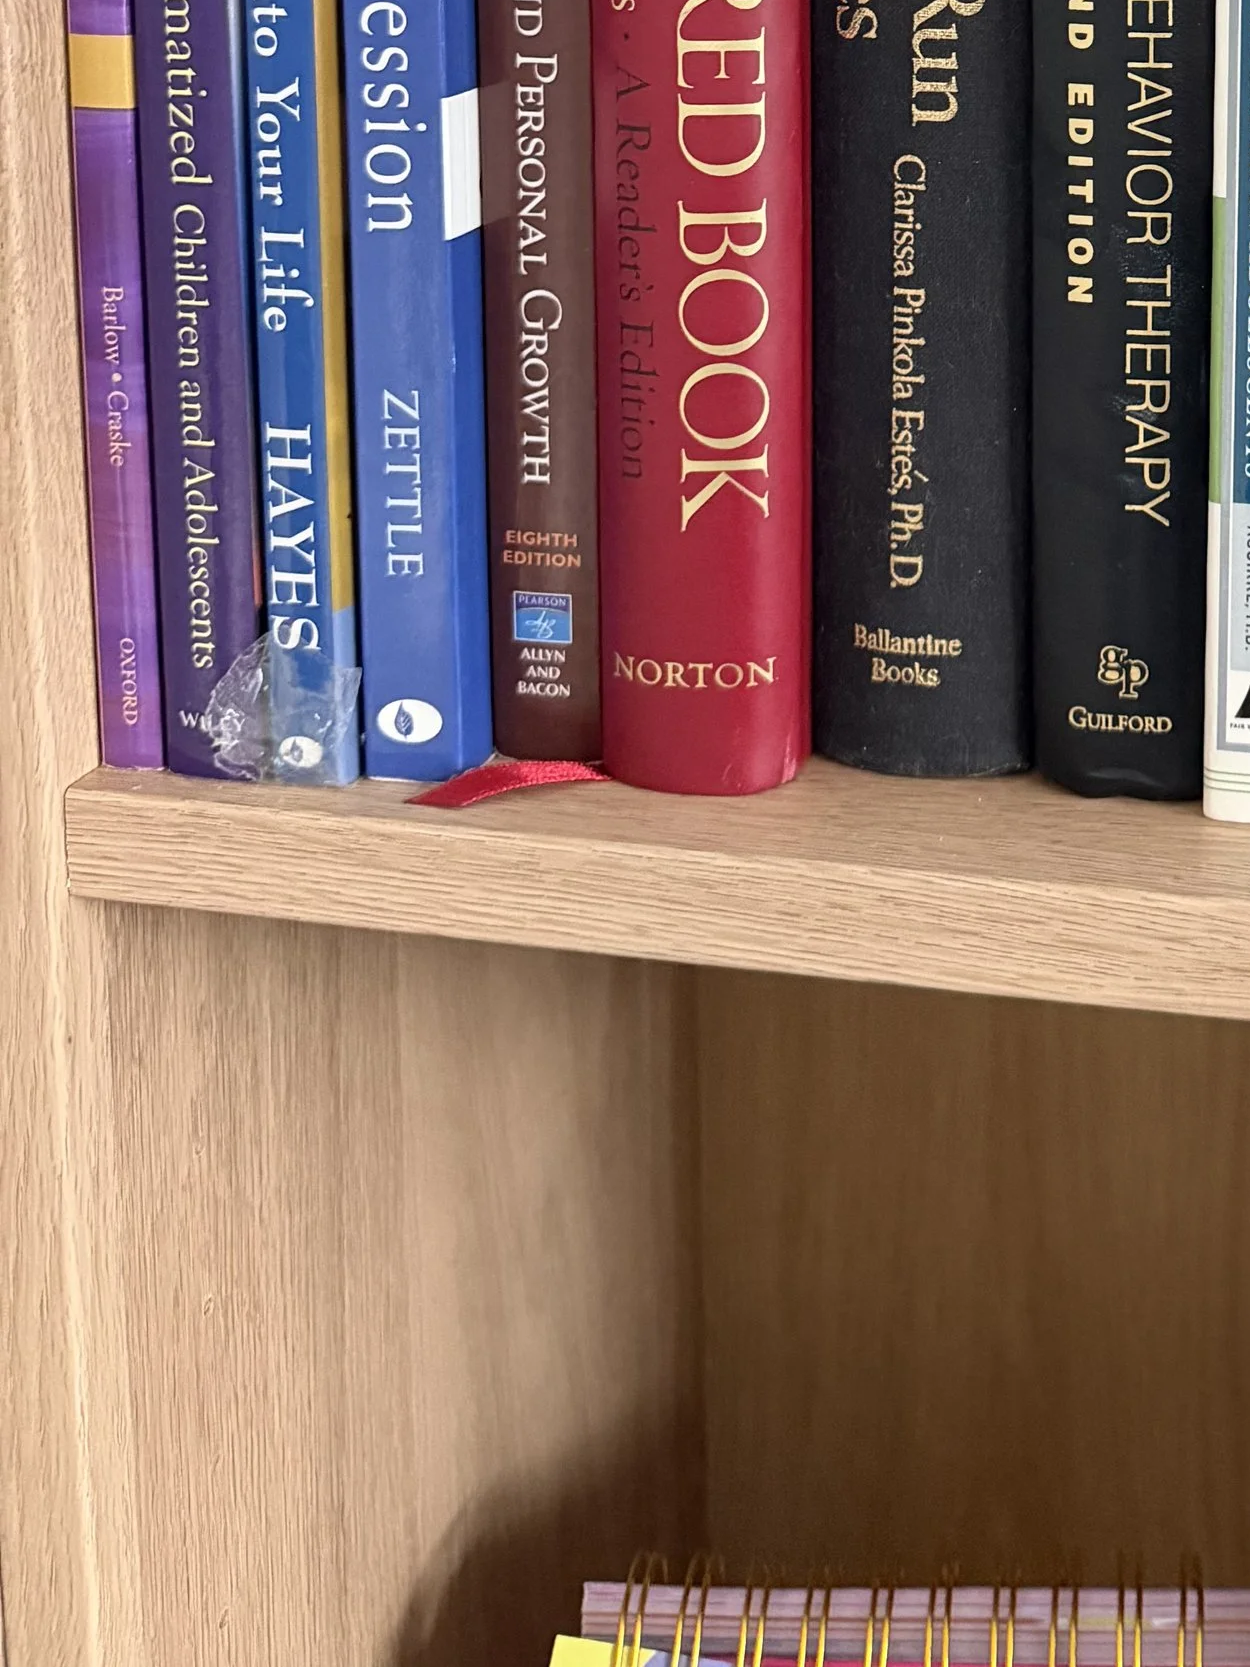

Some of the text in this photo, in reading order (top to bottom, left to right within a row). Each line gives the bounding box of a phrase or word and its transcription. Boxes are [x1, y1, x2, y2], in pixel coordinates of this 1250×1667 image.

[256, 77, 300, 207] Your
[613, 66, 651, 102] A
[515, 53, 558, 275] PERSONAL
[1067, 84, 1095, 304] EDITION
[173, 203, 210, 368] Children
[261, 227, 315, 333] Life
[100, 285, 132, 468] Barlow Craske
[179, 378, 215, 447] and
[520, 289, 563, 485] GROWTH
[618, 321, 661, 480] Edition
[677, 198, 770, 532] BOOK
[888, 153, 926, 589] Clarissa Pinkola Ph.D.
[1124, 264, 1172, 527] THERAPY
[266, 421, 321, 652] HAYES
[383, 390, 424, 577] ZETTLE
[505, 529, 578, 548] EIGHTH
[182, 458, 220, 670] Adolescents
[503, 549, 582, 568] EDITION
[518, 595, 567, 607] PEARSON
[119, 637, 139, 726] OXFORD
[516, 680, 571, 697] BACON
[520, 646, 566, 663] ALLYN
[526, 664, 561, 680] AND
[613, 652, 777, 689] NORTON
[853, 623, 963, 658] Ballantine
[870, 658, 941, 688] Books
